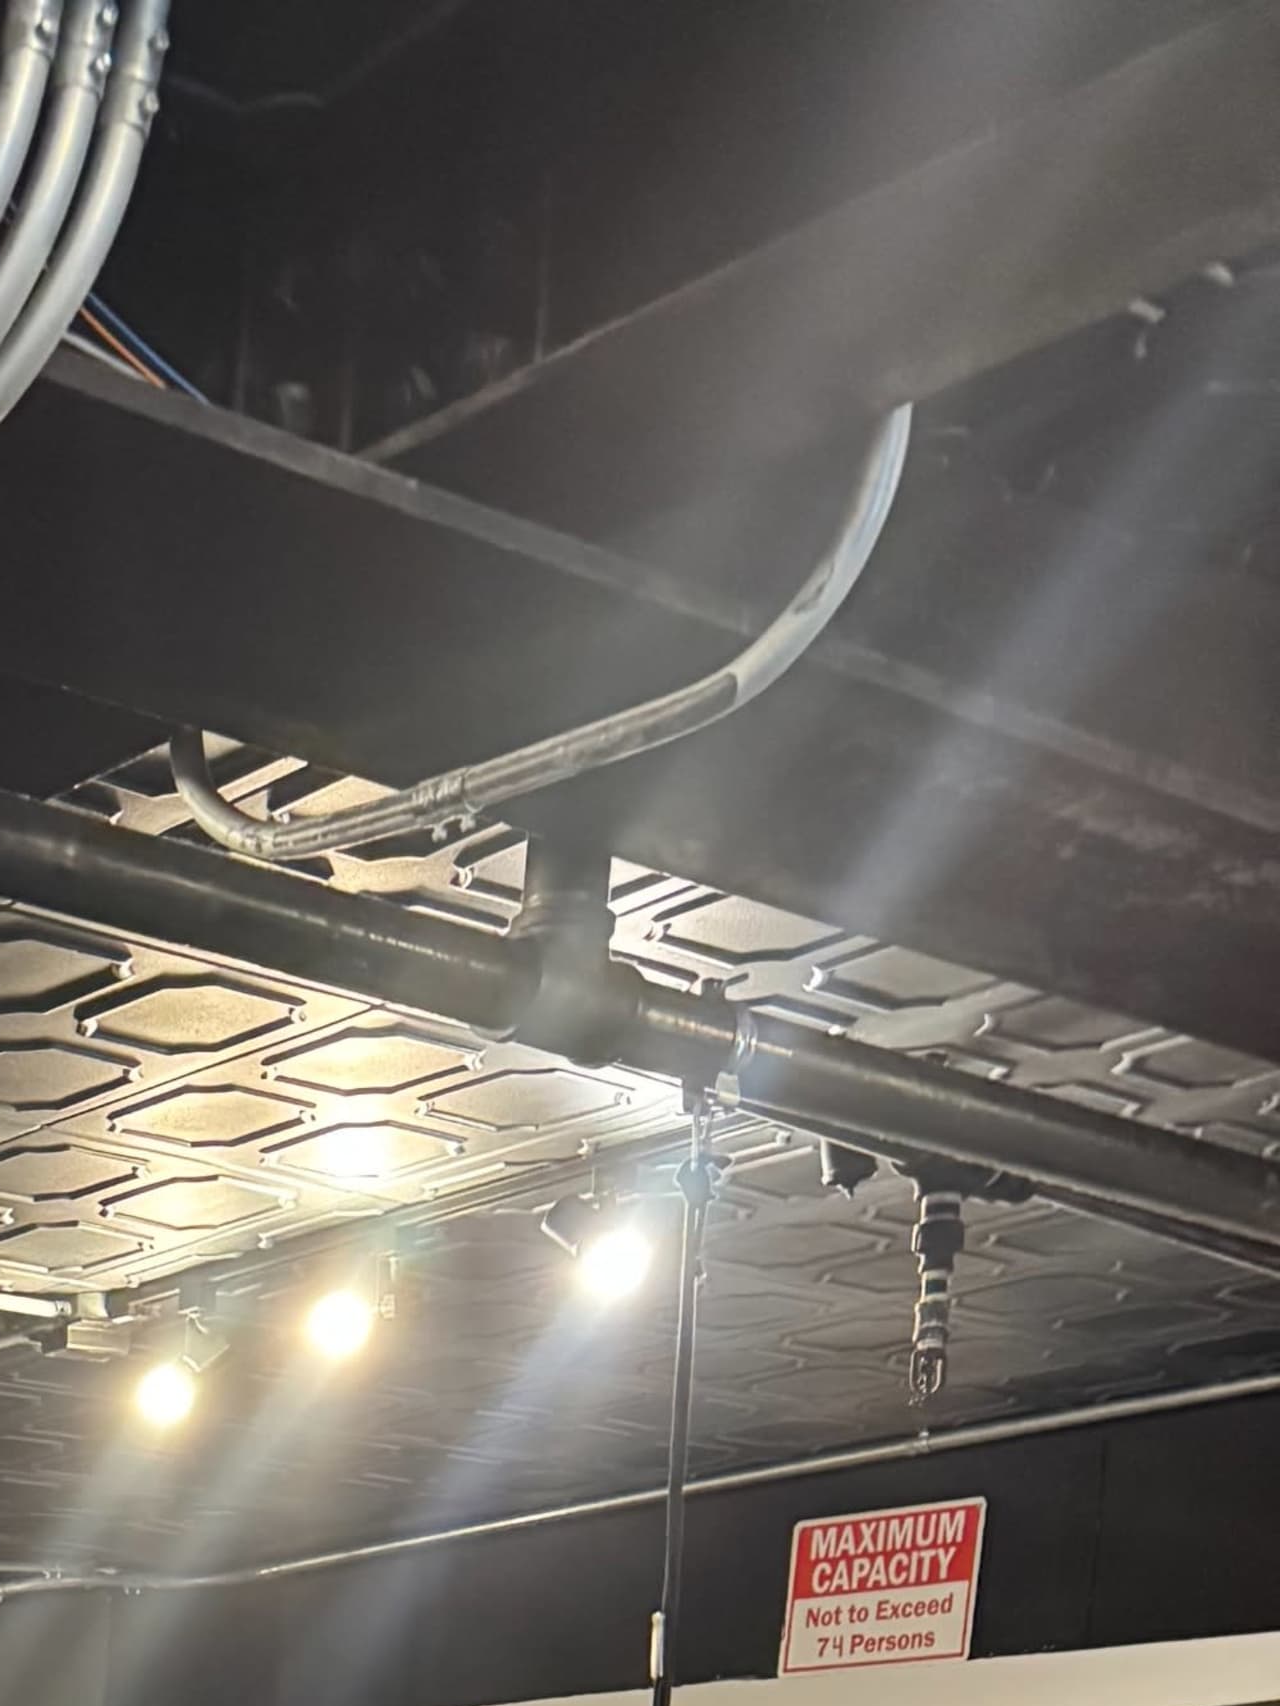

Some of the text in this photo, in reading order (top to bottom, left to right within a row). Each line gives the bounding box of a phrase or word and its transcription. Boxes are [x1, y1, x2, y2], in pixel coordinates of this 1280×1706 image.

[810, 1510, 966, 1560] MAXIMUM
[812, 1547, 956, 1594] CAPACITY
[805, 1592, 954, 1629] Not to Exceed
[817, 1631, 936, 1658] 74 Persons
